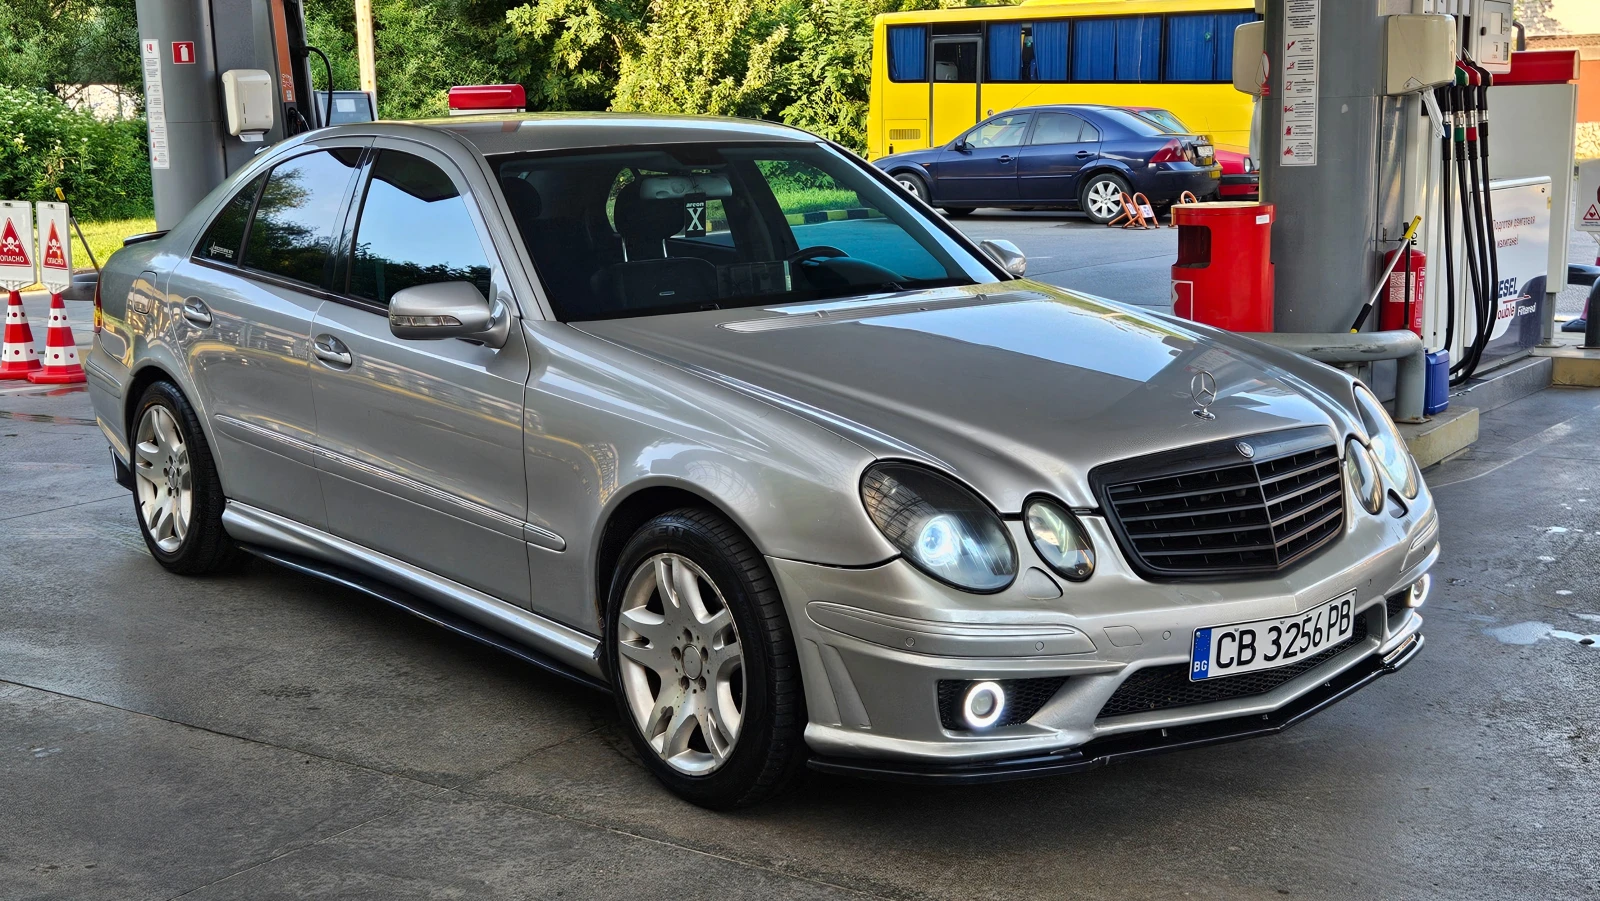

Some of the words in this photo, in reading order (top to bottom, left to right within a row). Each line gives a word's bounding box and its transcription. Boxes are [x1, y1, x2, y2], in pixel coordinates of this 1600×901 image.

[687, 207, 704, 231] X
[0, 255, 24, 263] ОПАСНО
[47, 257, 64, 265] ОПАСНО
[1498, 277, 1518, 298] ESEL
[1498, 304, 1515, 320] ouble
[1518, 302, 1536, 316] Filtered
[1216, 629, 1257, 669] CB
[1263, 611, 1322, 662] 3256
[1327, 599, 1351, 642] PB
[1194, 660, 1208, 672] BG
